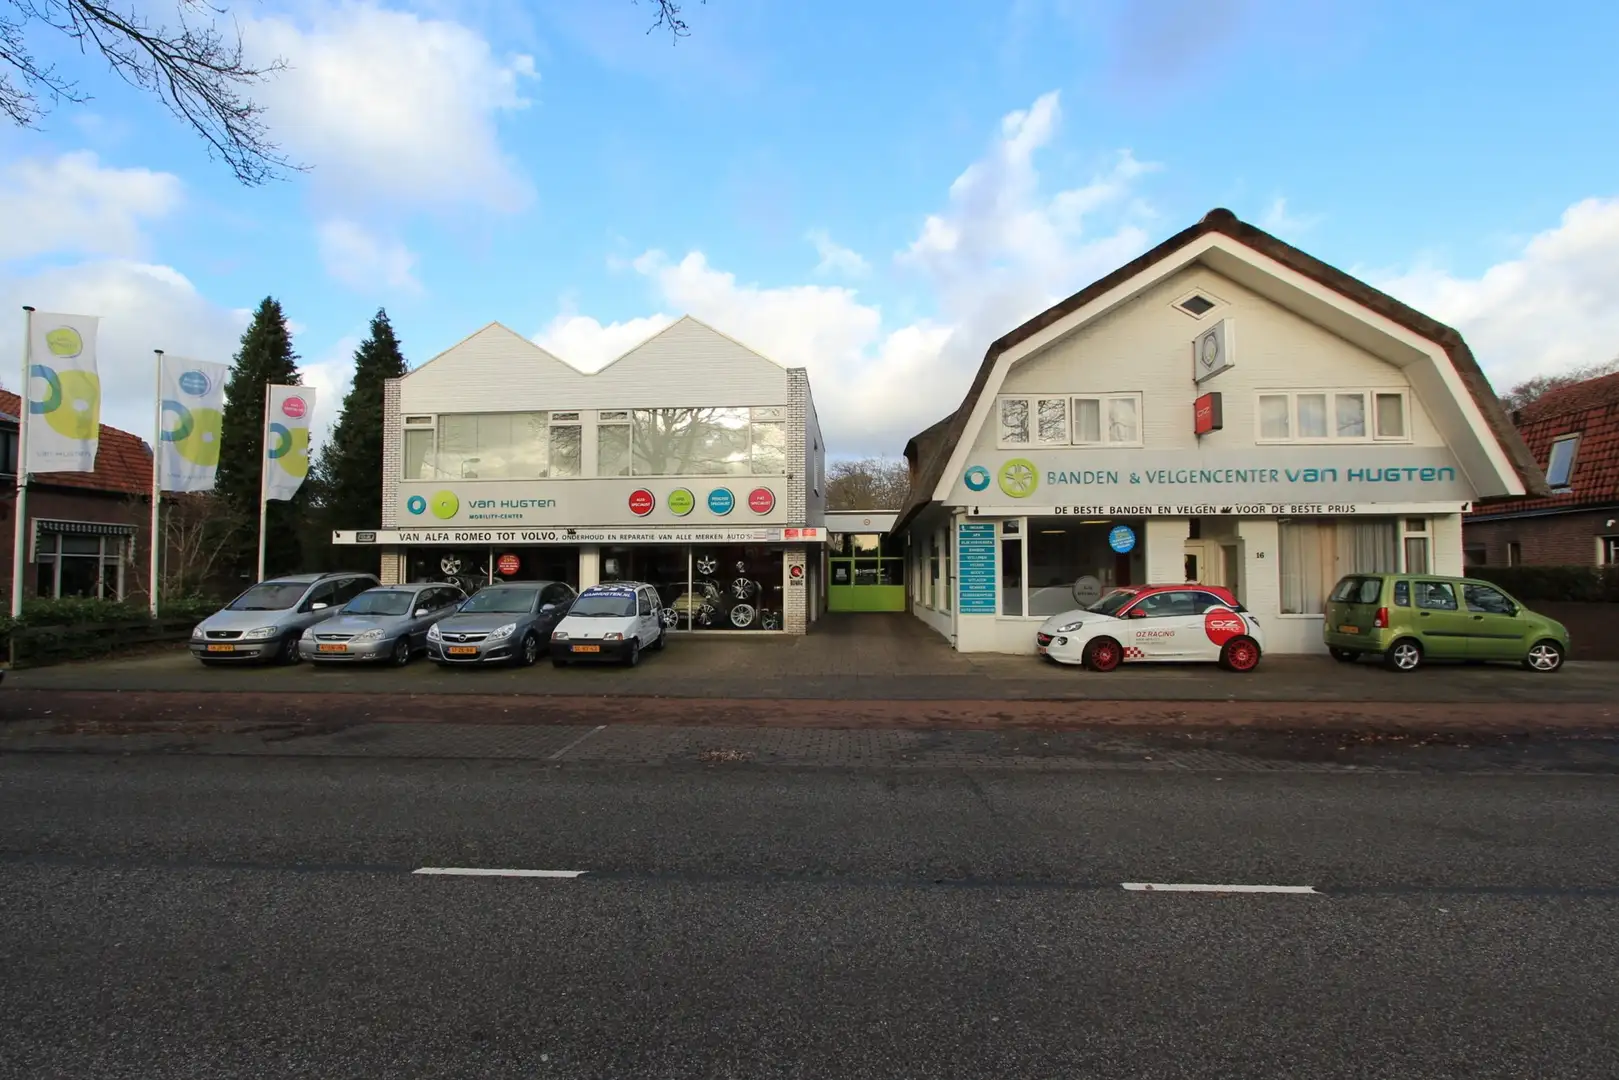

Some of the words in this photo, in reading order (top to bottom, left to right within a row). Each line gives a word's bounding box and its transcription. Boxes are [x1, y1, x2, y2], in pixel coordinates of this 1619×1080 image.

[1047, 470, 1118, 485] BANDEN
[1129, 472, 1141, 485] &
[1145, 469, 1278, 484] VELGENCENTER
[1054, 506, 1068, 514] DE
[1073, 506, 1104, 514] BESTE
[1109, 506, 1152, 514] BANDEN
[1158, 506, 1171, 514] EN
[1176, 506, 1217, 514] VELGEN
[1236, 505, 1266, 513] VOOR
[1271, 505, 1285, 513] DE
[1290, 505, 1323, 513] BESTE
[1328, 505, 1356, 513] PRIJS
[399, 532, 420, 541] VAN
[425, 532, 450, 541] ALFA
[455, 532, 492, 541] ROMEO
[497, 532, 516, 541] TOT
[521, 532, 559, 541] VOLVO,
[1256, 551, 1265, 559] 16
[1210, 620, 1239, 628] OZ
